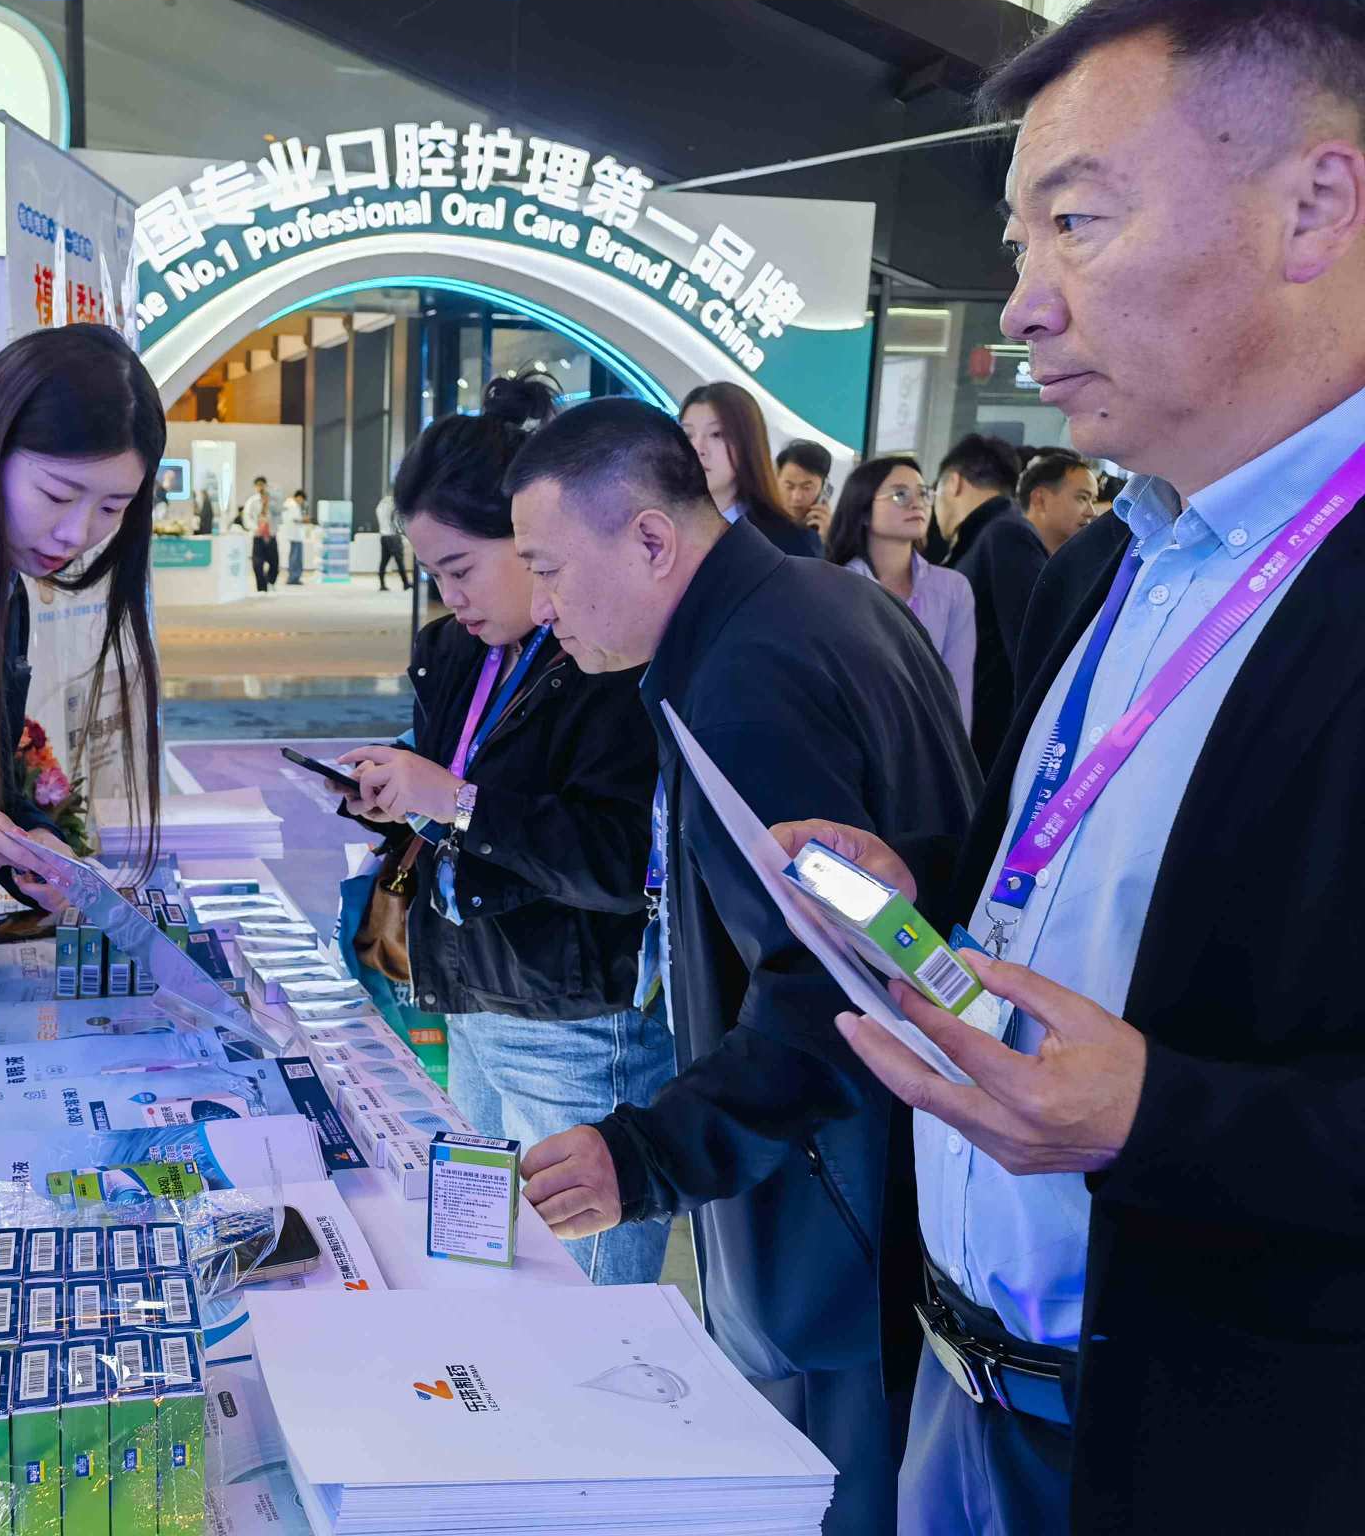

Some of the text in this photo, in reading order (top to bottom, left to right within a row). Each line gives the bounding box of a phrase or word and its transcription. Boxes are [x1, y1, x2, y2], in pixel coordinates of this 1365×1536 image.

[166, 192, 766, 375] No.1 Professional Oral Care Brand in China
[446, 1364, 480, 1413] 乐珠制药
